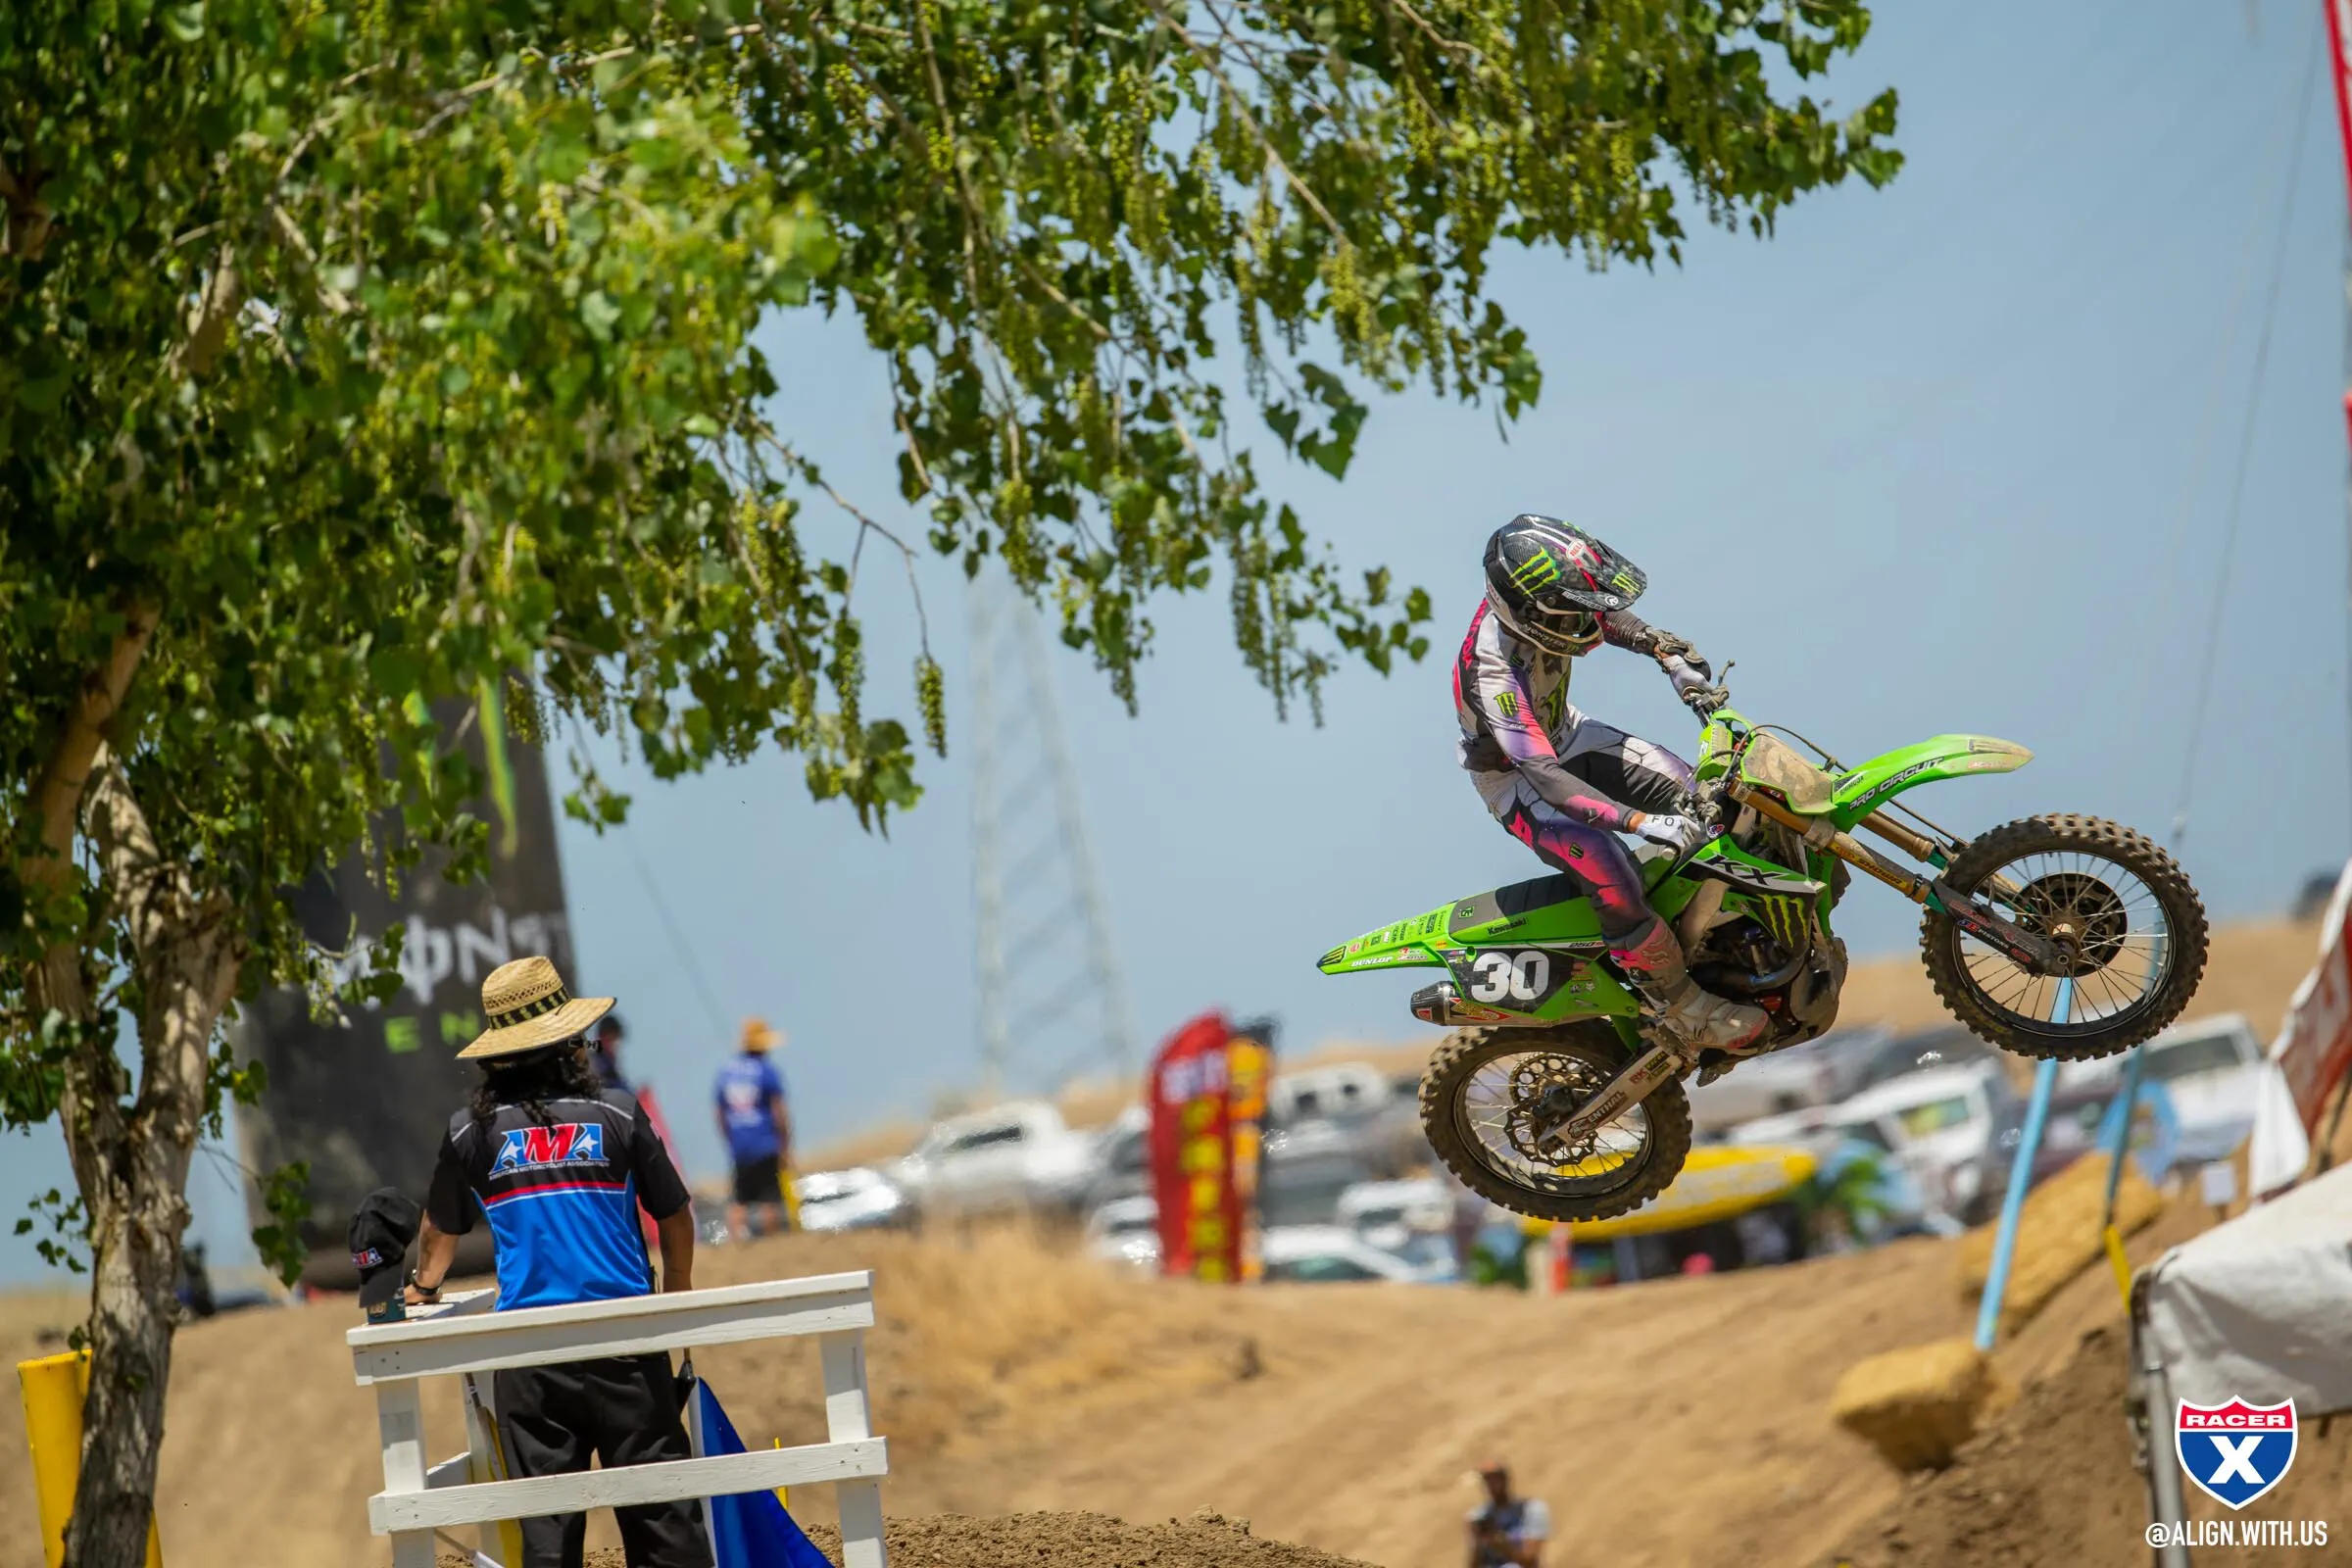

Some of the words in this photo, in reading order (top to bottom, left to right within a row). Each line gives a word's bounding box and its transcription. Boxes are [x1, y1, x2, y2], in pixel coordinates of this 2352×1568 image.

[1849, 787, 1876, 811] PRO
[1879, 757, 1944, 793] CIRCUIT
[1704, 853, 1788, 885] KX
[1351, 956, 1393, 967] DUNLOP
[1471, 951, 1549, 1003] 30
[488, 1123, 611, 1175] AMA
